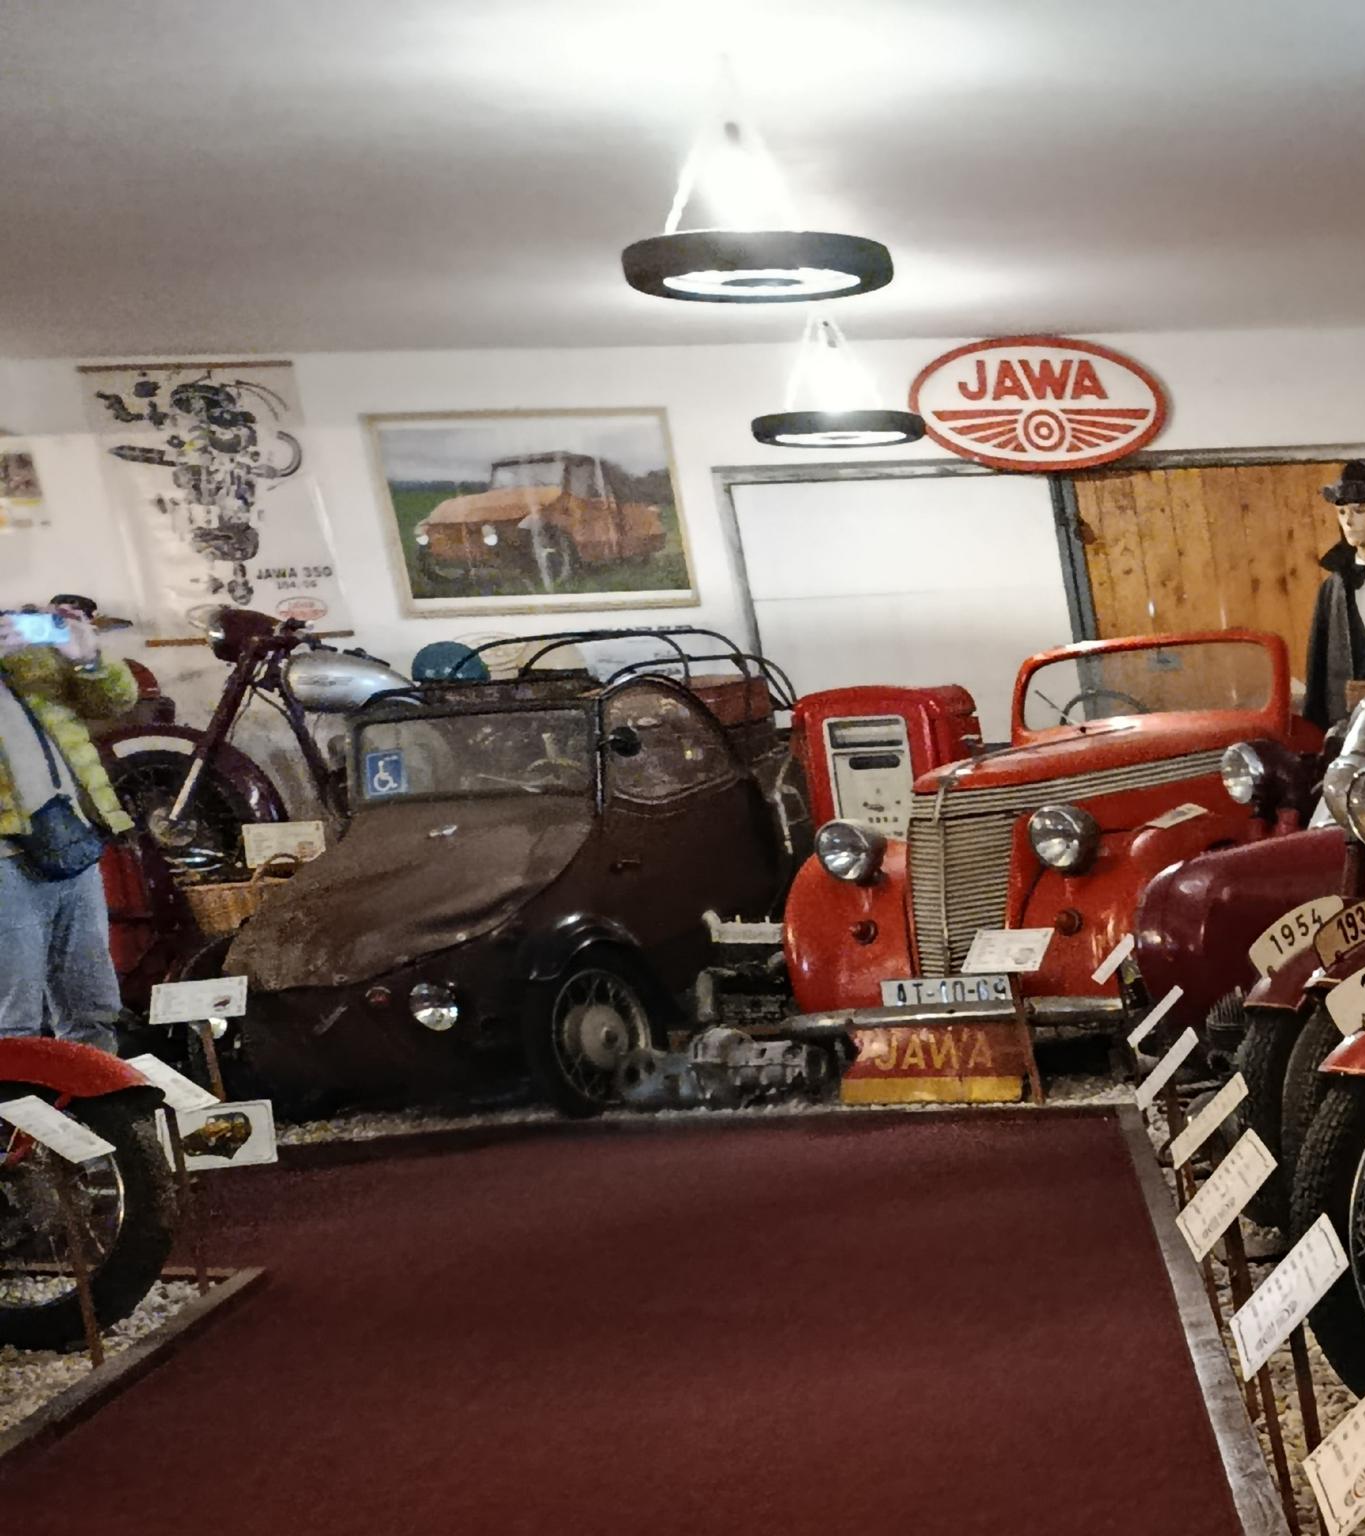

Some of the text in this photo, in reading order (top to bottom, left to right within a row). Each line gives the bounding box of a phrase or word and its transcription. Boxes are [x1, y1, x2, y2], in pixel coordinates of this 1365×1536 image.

[958, 359, 1109, 401] JAWA
[1269, 907, 1323, 955] 1954
[875, 1030, 993, 1072] JAWA
